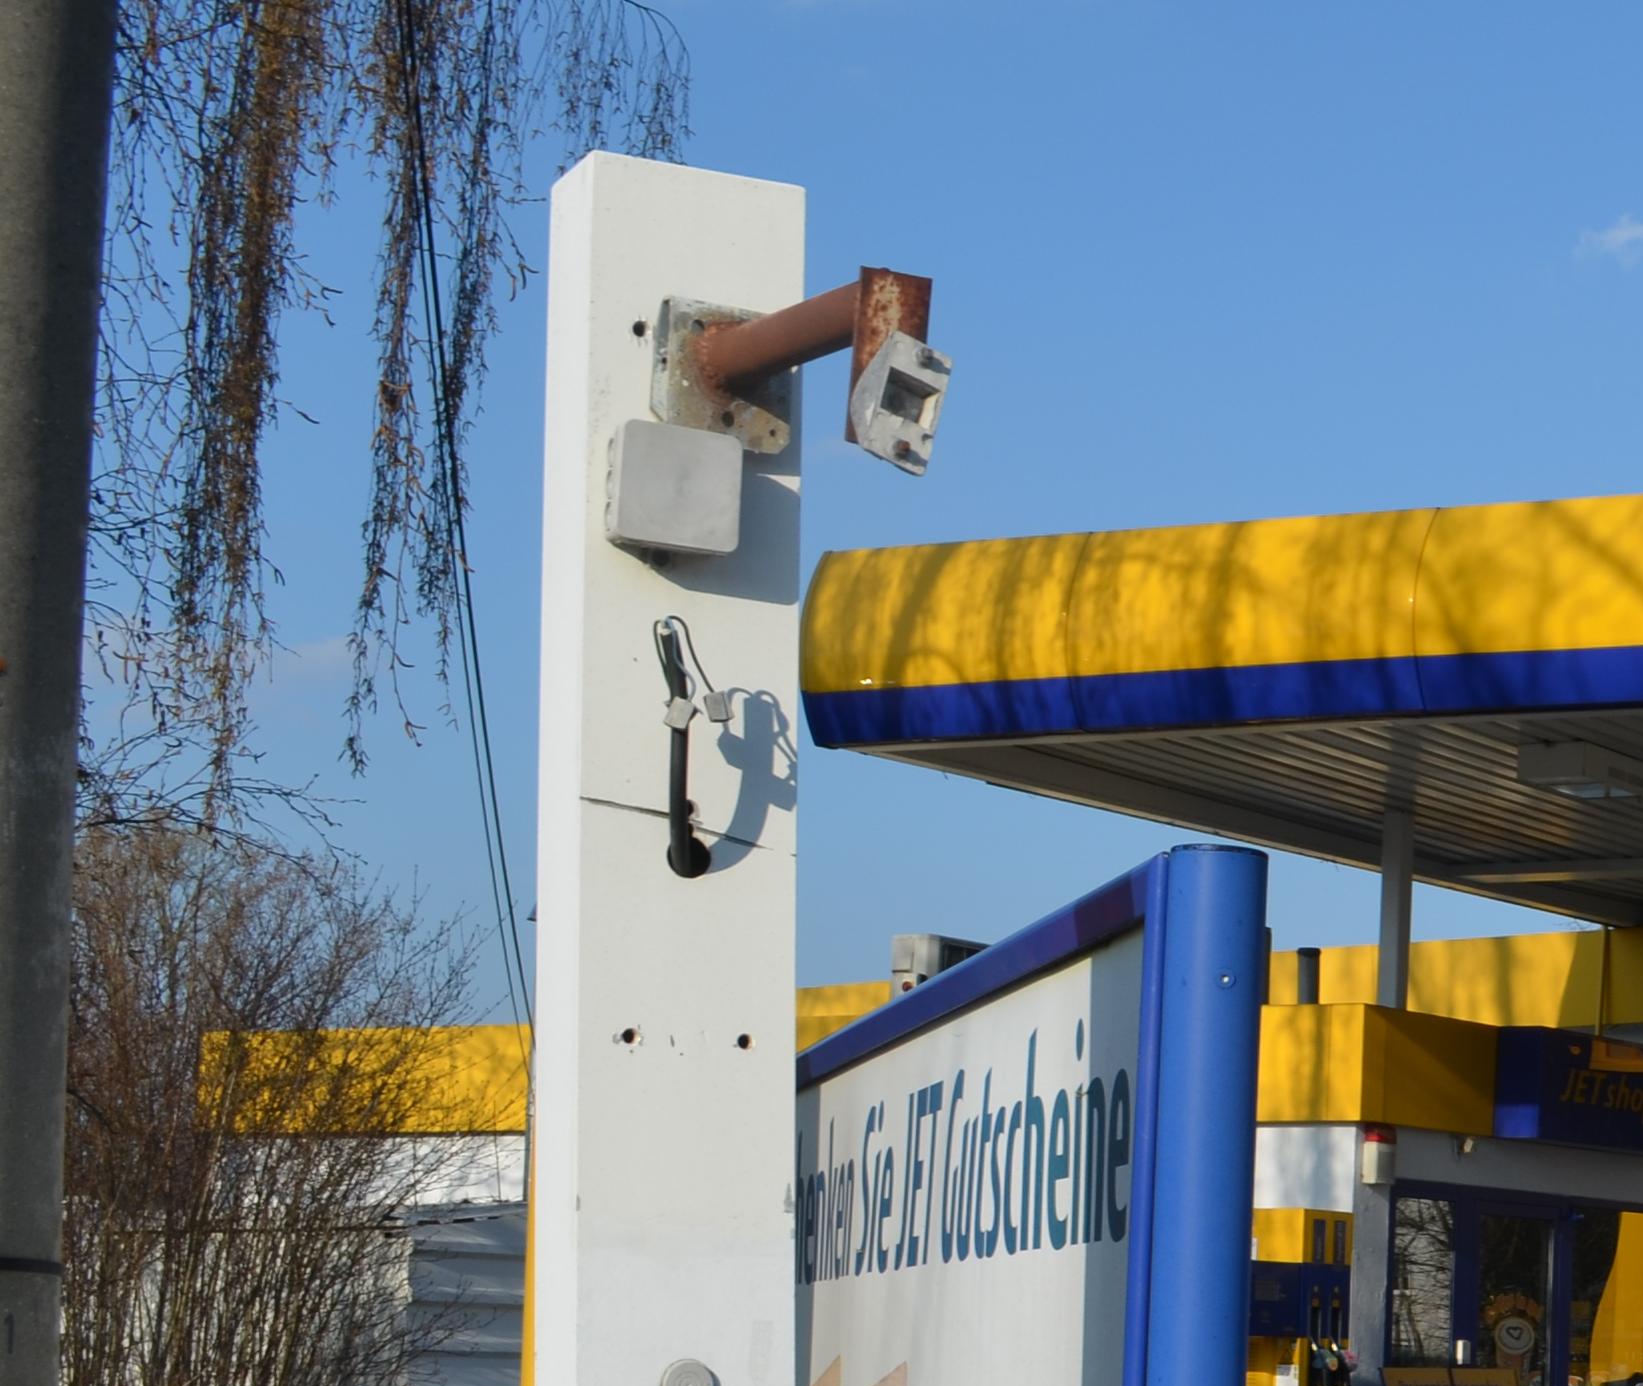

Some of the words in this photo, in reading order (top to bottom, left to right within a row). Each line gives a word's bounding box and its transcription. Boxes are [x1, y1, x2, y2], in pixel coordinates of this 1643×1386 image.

[854, 1099, 894, 1277] Sie
[894, 1080, 944, 1271] JET
[941, 1018, 1131, 1264] Gutscheine
[1560, 1067, 1607, 1105] JET
